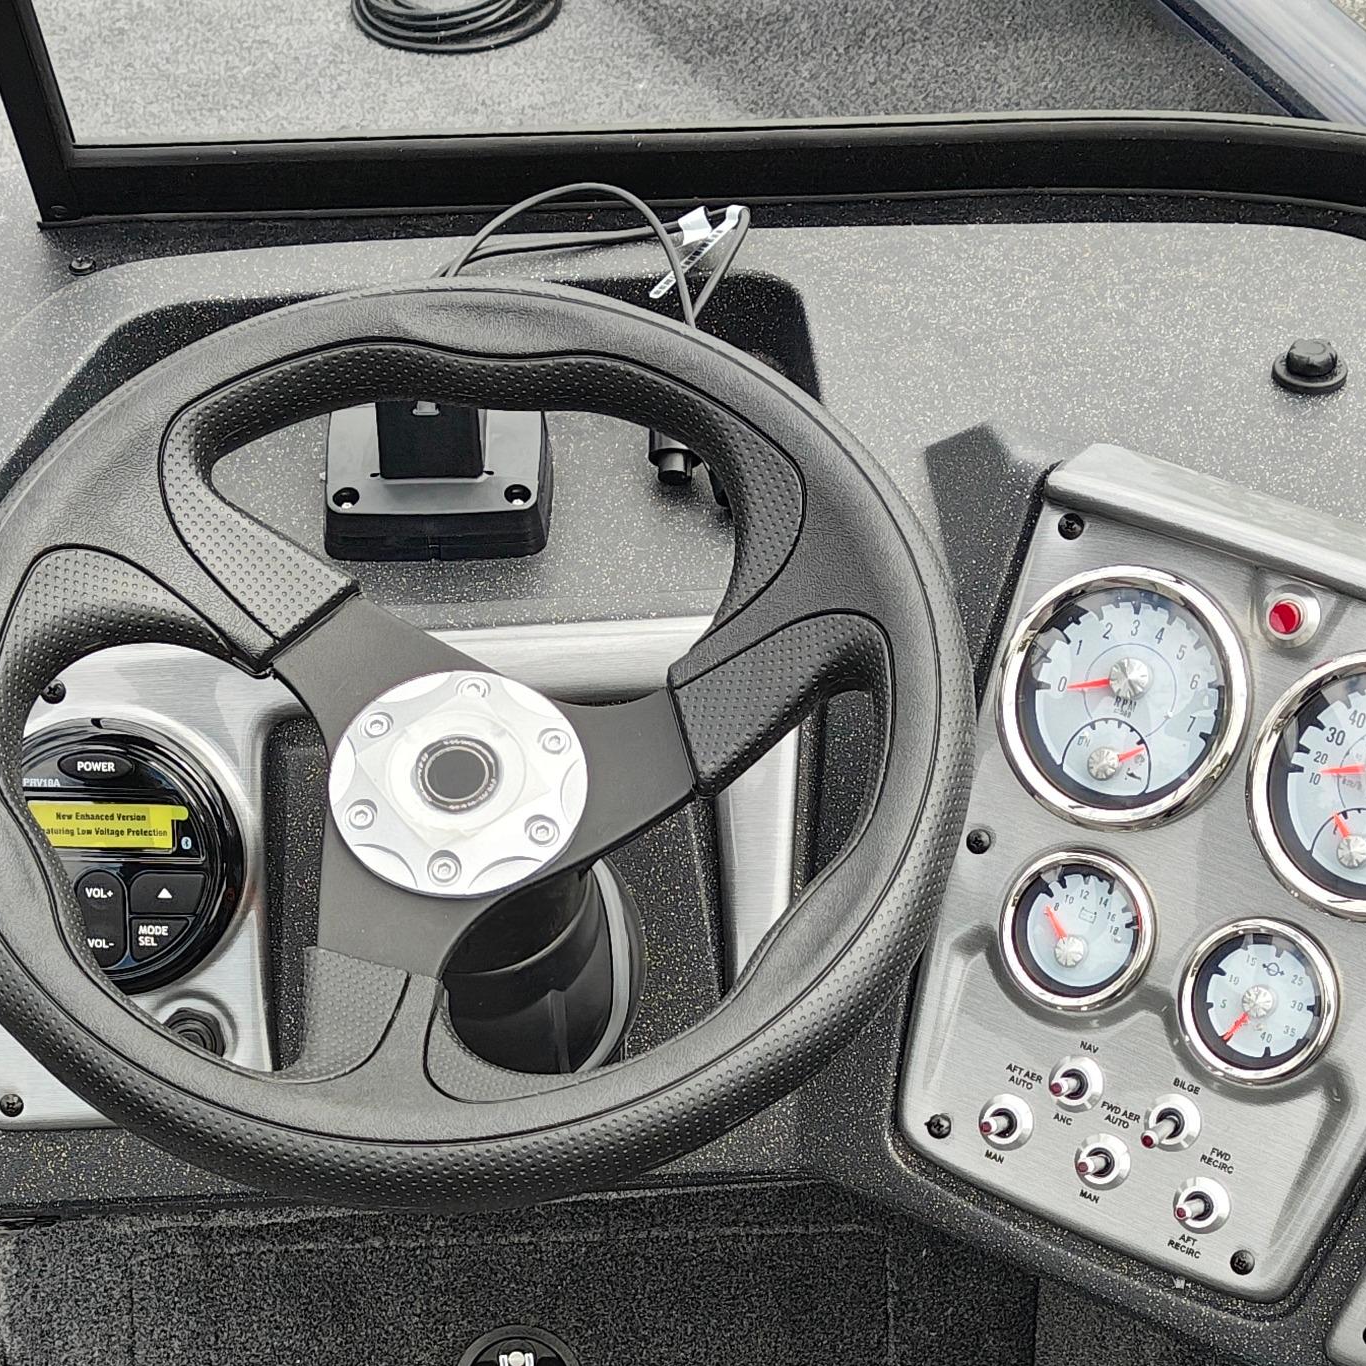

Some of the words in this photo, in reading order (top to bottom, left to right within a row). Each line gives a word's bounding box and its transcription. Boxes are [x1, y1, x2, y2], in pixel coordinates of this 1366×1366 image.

[1103, 622, 1114, 640] 2
[1130, 619, 1140, 637] 3
[1155, 627, 1165, 644] 4
[1076, 640, 1083, 655] 1
[1177, 645, 1187, 660] 5
[1057, 676, 1068, 693] 0
[1189, 674, 1201, 690] 6
[1186, 716, 1197, 732] 7
[1349, 709, 1366, 729] 40
[1326, 727, 1346, 746] 30
[1314, 751, 1328, 765] 20
[77, 761, 116, 772] POWER
[1309, 772, 1321, 785] 10
[55, 812, 73, 821] New
[75, 813, 114, 821] Enhanced
[116, 813, 146, 821] Version
[43, 828, 75, 837] aturing
[77, 828, 92, 836] Low
[95, 828, 125, 837] Voltage
[127, 828, 168, 837] Protection
[85, 887, 114, 898] VOL+
[1064, 894, 1074, 905] 10
[1080, 889, 1090, 900] 12
[1099, 897, 1109, 908] 14
[1106, 911, 1116, 921] 16
[138, 925, 169, 936] MODE
[1109, 926, 1119, 936] 18
[87, 938, 115, 948] VOL-
[138, 936, 158, 946] SEL
[1246, 954, 1257, 966] 15
[1228, 974, 1239, 985] 10
[1291, 974, 1304, 986] 25
[1220, 999, 1227, 1008] 5
[1291, 1000, 1304, 1012] 30
[1260, 1031, 1272, 1043] 40
[1283, 1025, 1296, 1037] 35
[1080, 1040, 1099, 1054] NAV
[1006, 1063, 1024, 1076] AFT
[1023, 1071, 1043, 1084] AER
[1008, 1075, 1034, 1090] AUTO
[1173, 1077, 1201, 1095] BILGE
[1053, 1112, 1073, 1126] ANC
[1100, 1101, 1121, 1115] FWD
[1121, 1109, 1141, 1123] AER
[1104, 1114, 1129, 1129] AUTO
[984, 1149, 1005, 1164] MAN
[1210, 1147, 1231, 1161] FWD
[1200, 1154, 1234, 1175] RECIRC
[1079, 1189, 1099, 1203] MAN
[1179, 1234, 1197, 1246] AFT
[1167, 1239, 1202, 1259] RECIRC
